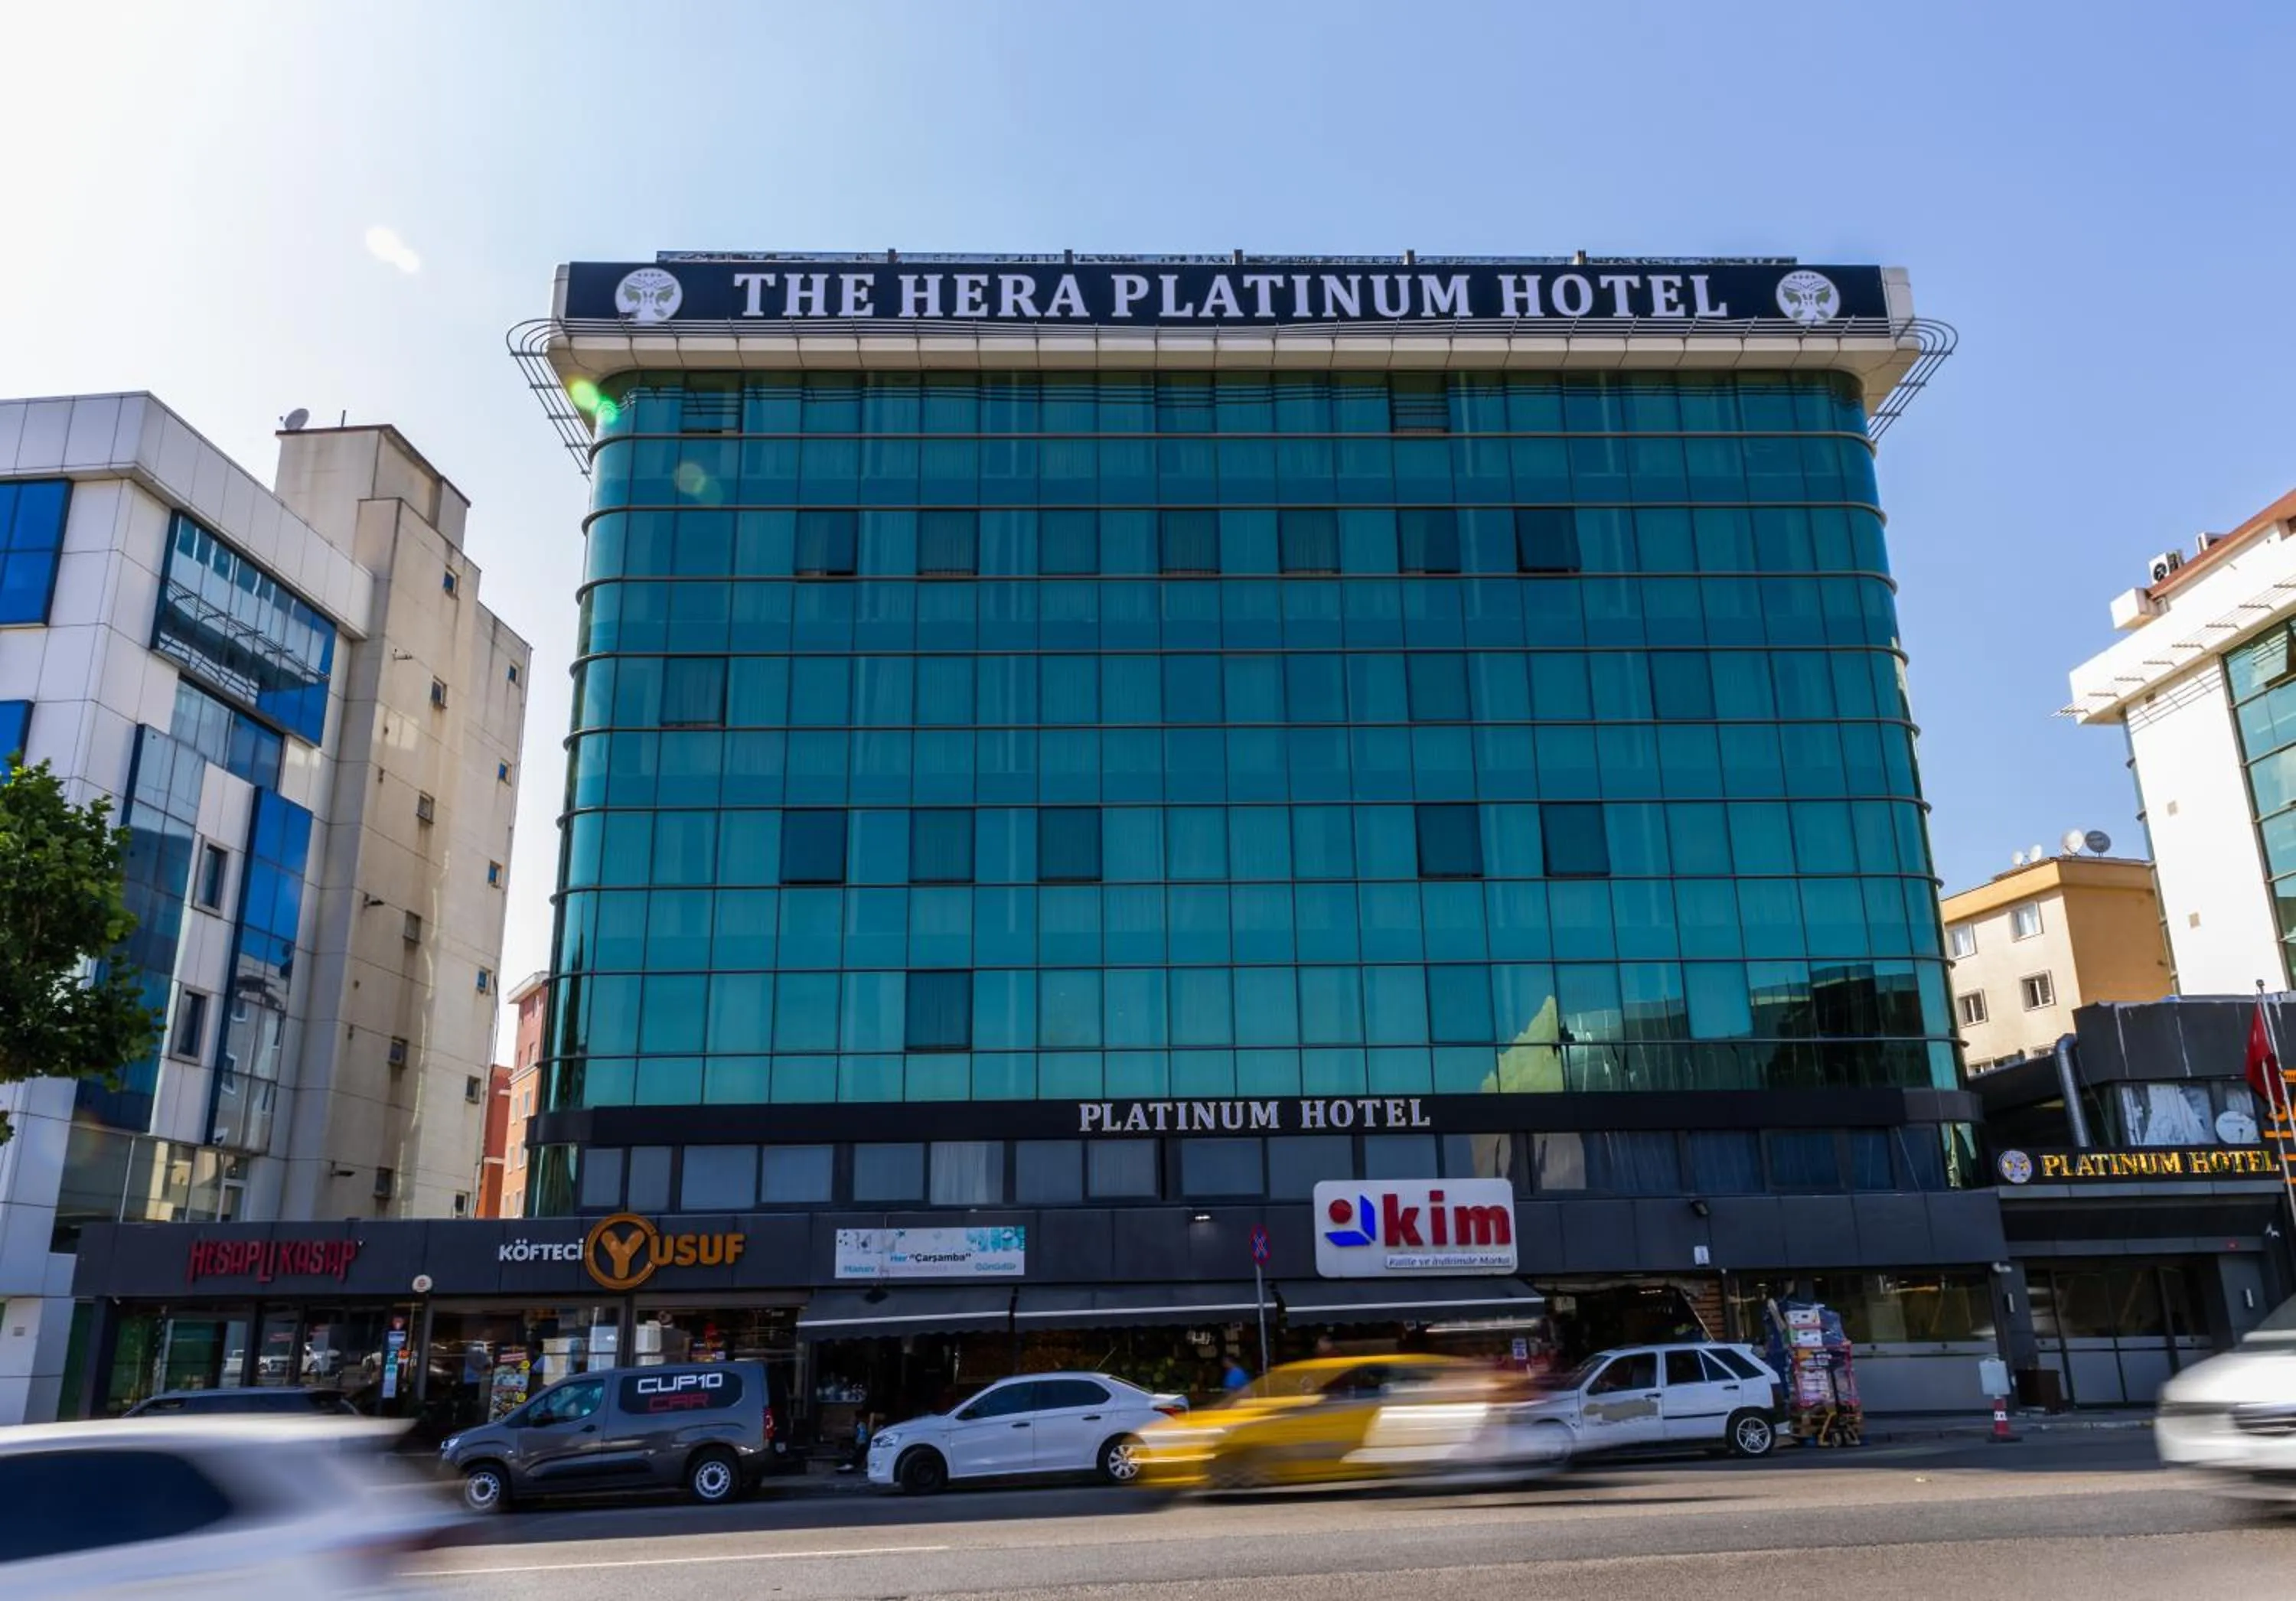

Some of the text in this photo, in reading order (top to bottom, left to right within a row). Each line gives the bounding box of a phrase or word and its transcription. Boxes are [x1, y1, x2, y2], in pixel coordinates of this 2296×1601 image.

[734, 272, 1728, 318] THE HERA PLATINUM HOTEL
[1078, 1098, 1431, 1132] PLATINUM HOTEL
[2039, 1149, 2280, 1177] PLATINUM HOTEL
[1381, 1189, 1512, 1247] kim
[279, 1240, 357, 1283] KASAP
[497, 1228, 745, 1280] KÖFTECİ YUSUF
[649, 1392, 710, 1413] CAR
